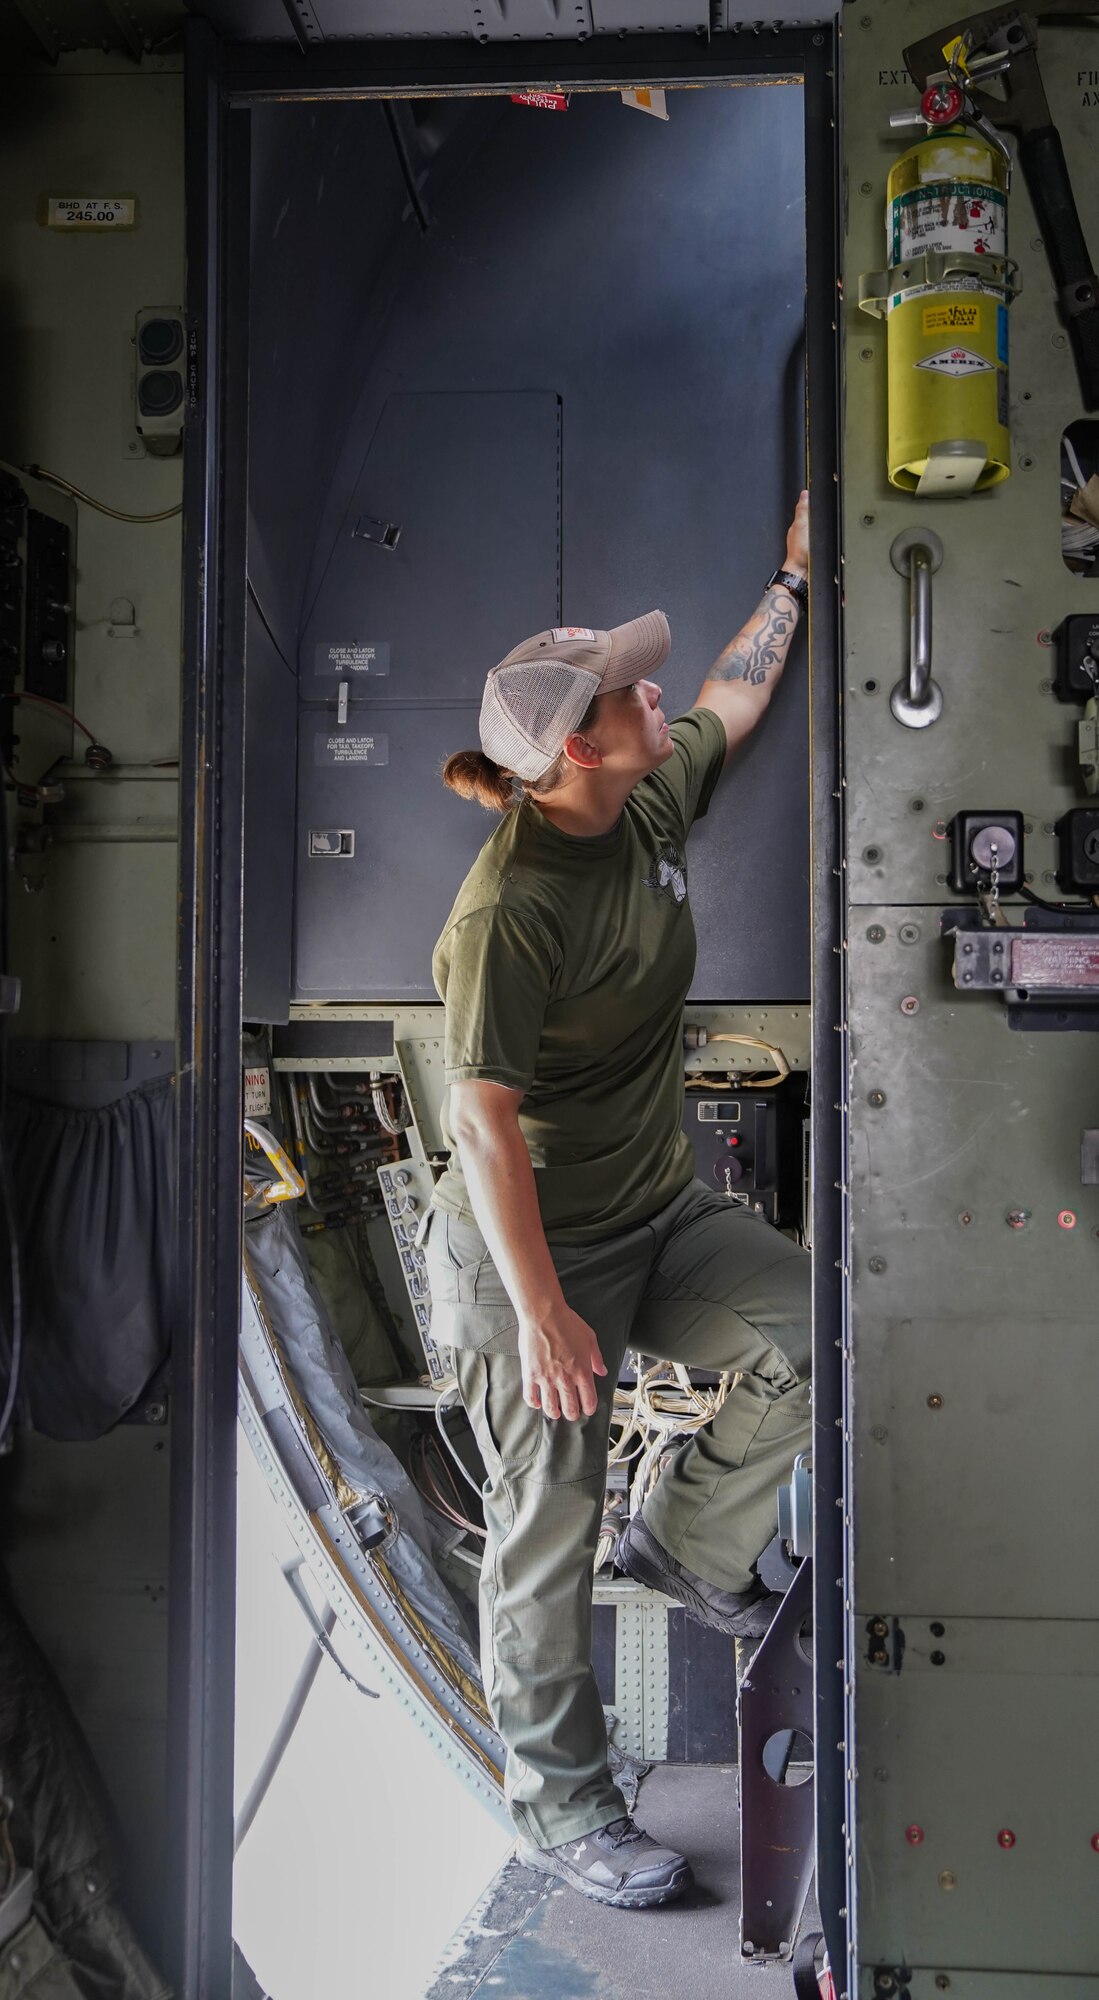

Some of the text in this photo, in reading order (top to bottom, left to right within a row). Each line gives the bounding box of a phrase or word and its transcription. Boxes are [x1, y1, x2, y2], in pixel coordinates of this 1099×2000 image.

[524, 98, 556, 110] PULL
[86, 202, 98, 210] AT
[67, 211, 114, 221] 245.00
[245, 1074, 266, 1086] NING
[249, 1103, 267, 1112] FLIGHT
